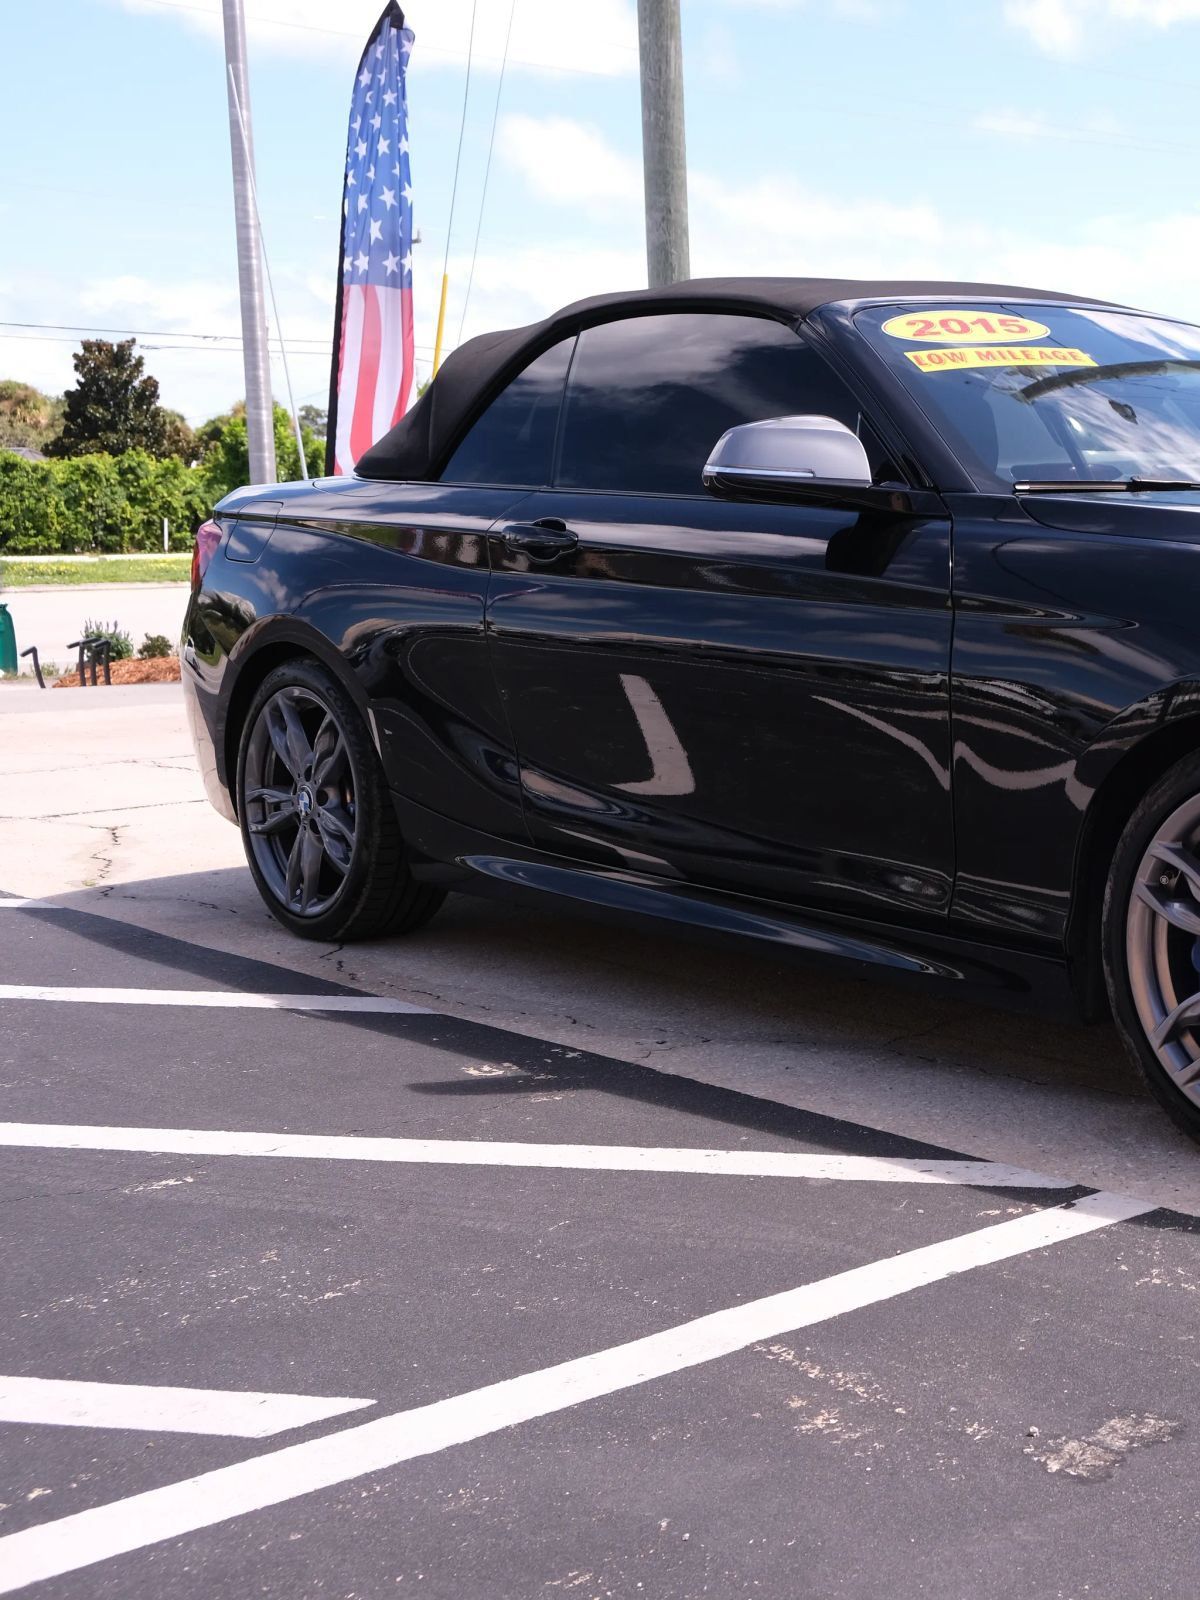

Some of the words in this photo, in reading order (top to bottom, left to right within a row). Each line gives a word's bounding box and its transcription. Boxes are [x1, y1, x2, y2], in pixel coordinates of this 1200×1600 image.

[906, 318, 1028, 336] 2015
[912, 351, 967, 366] LOW
[977, 350, 1083, 362] MILEAGE
